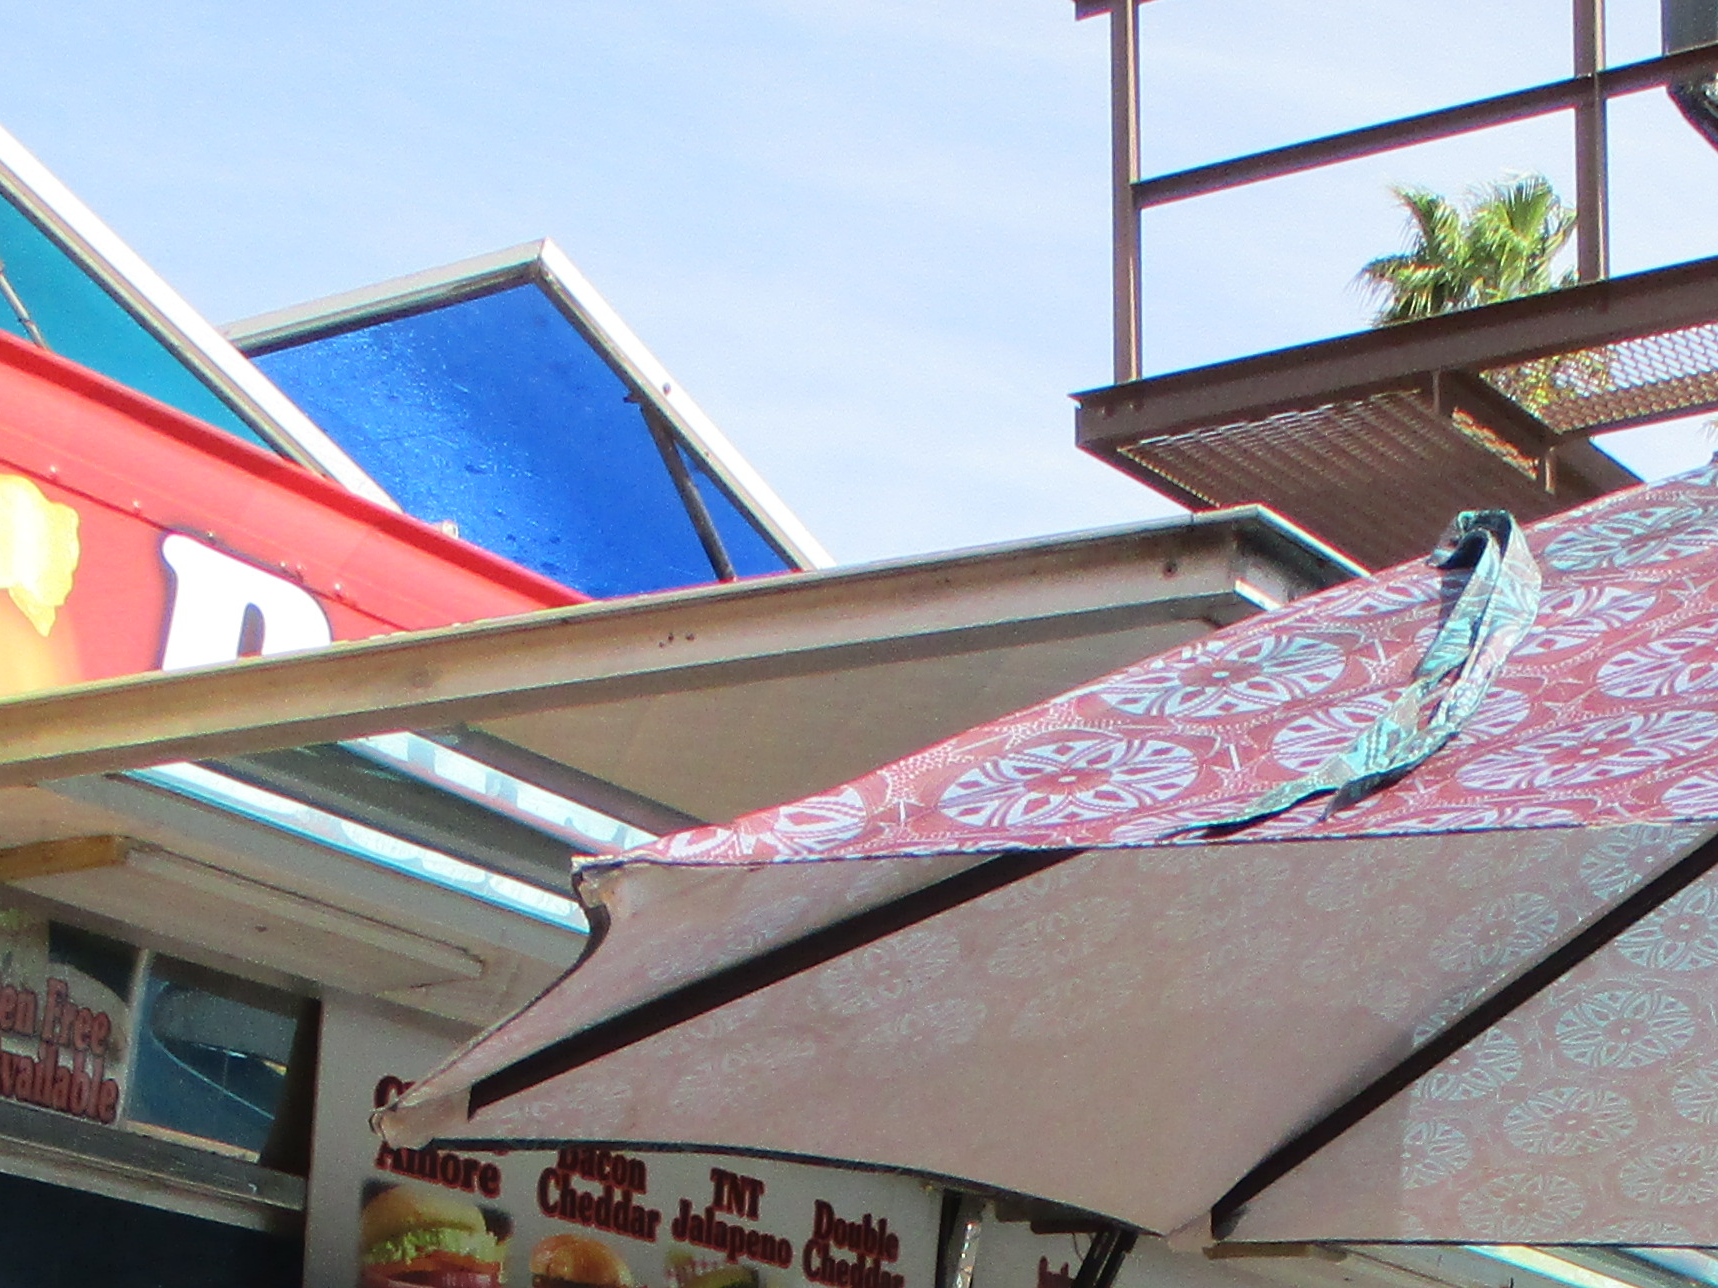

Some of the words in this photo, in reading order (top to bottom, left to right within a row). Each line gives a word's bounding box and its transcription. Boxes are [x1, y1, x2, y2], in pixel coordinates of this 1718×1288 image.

[42, 976, 111, 1056] Free
[537, 1167, 662, 1243] Cheddar
[710, 1167, 766, 1221] TNT
[671, 1199, 793, 1269] Jalapeno
[814, 1199, 899, 1263] Double
